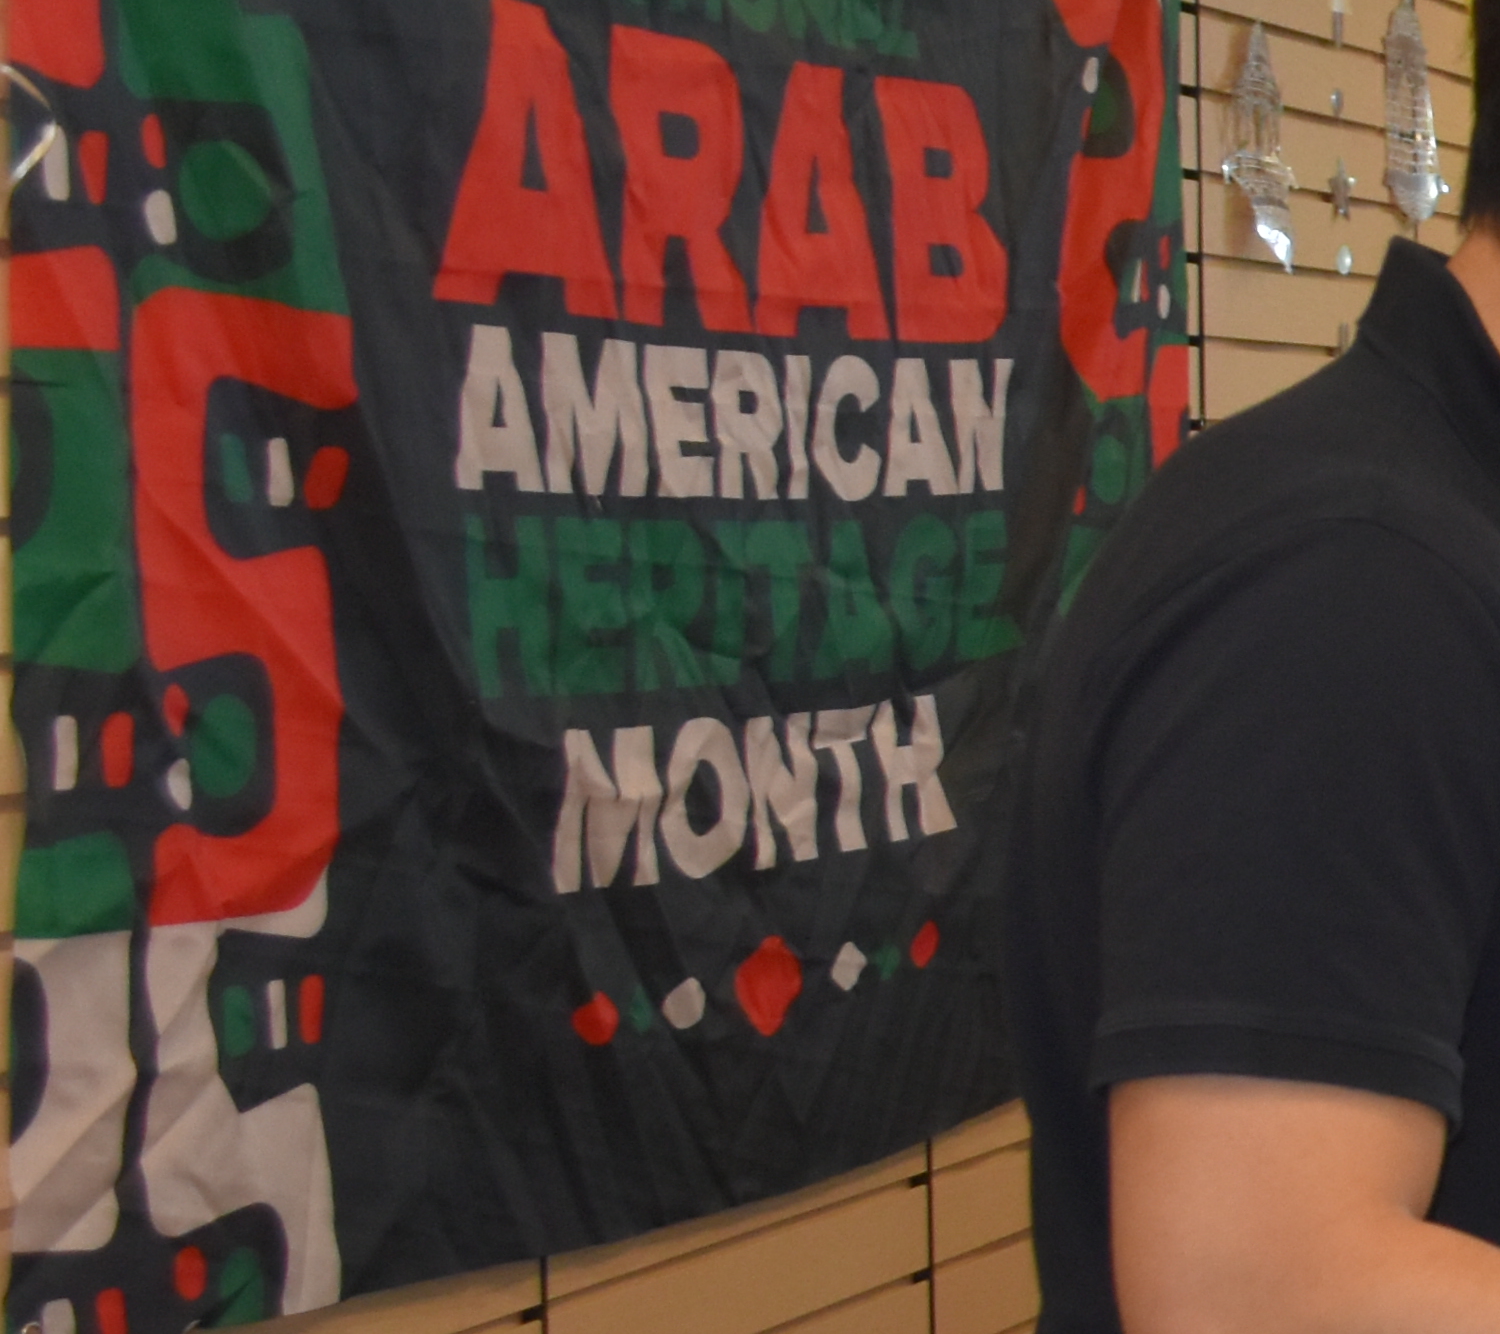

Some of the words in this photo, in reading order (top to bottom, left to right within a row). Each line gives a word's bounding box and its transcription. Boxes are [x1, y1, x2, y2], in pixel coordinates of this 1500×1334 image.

[455, 323, 1015, 501] AMERICAN
[464, 509, 1028, 699] HERITAGE
[552, 694, 958, 894] MONTH
